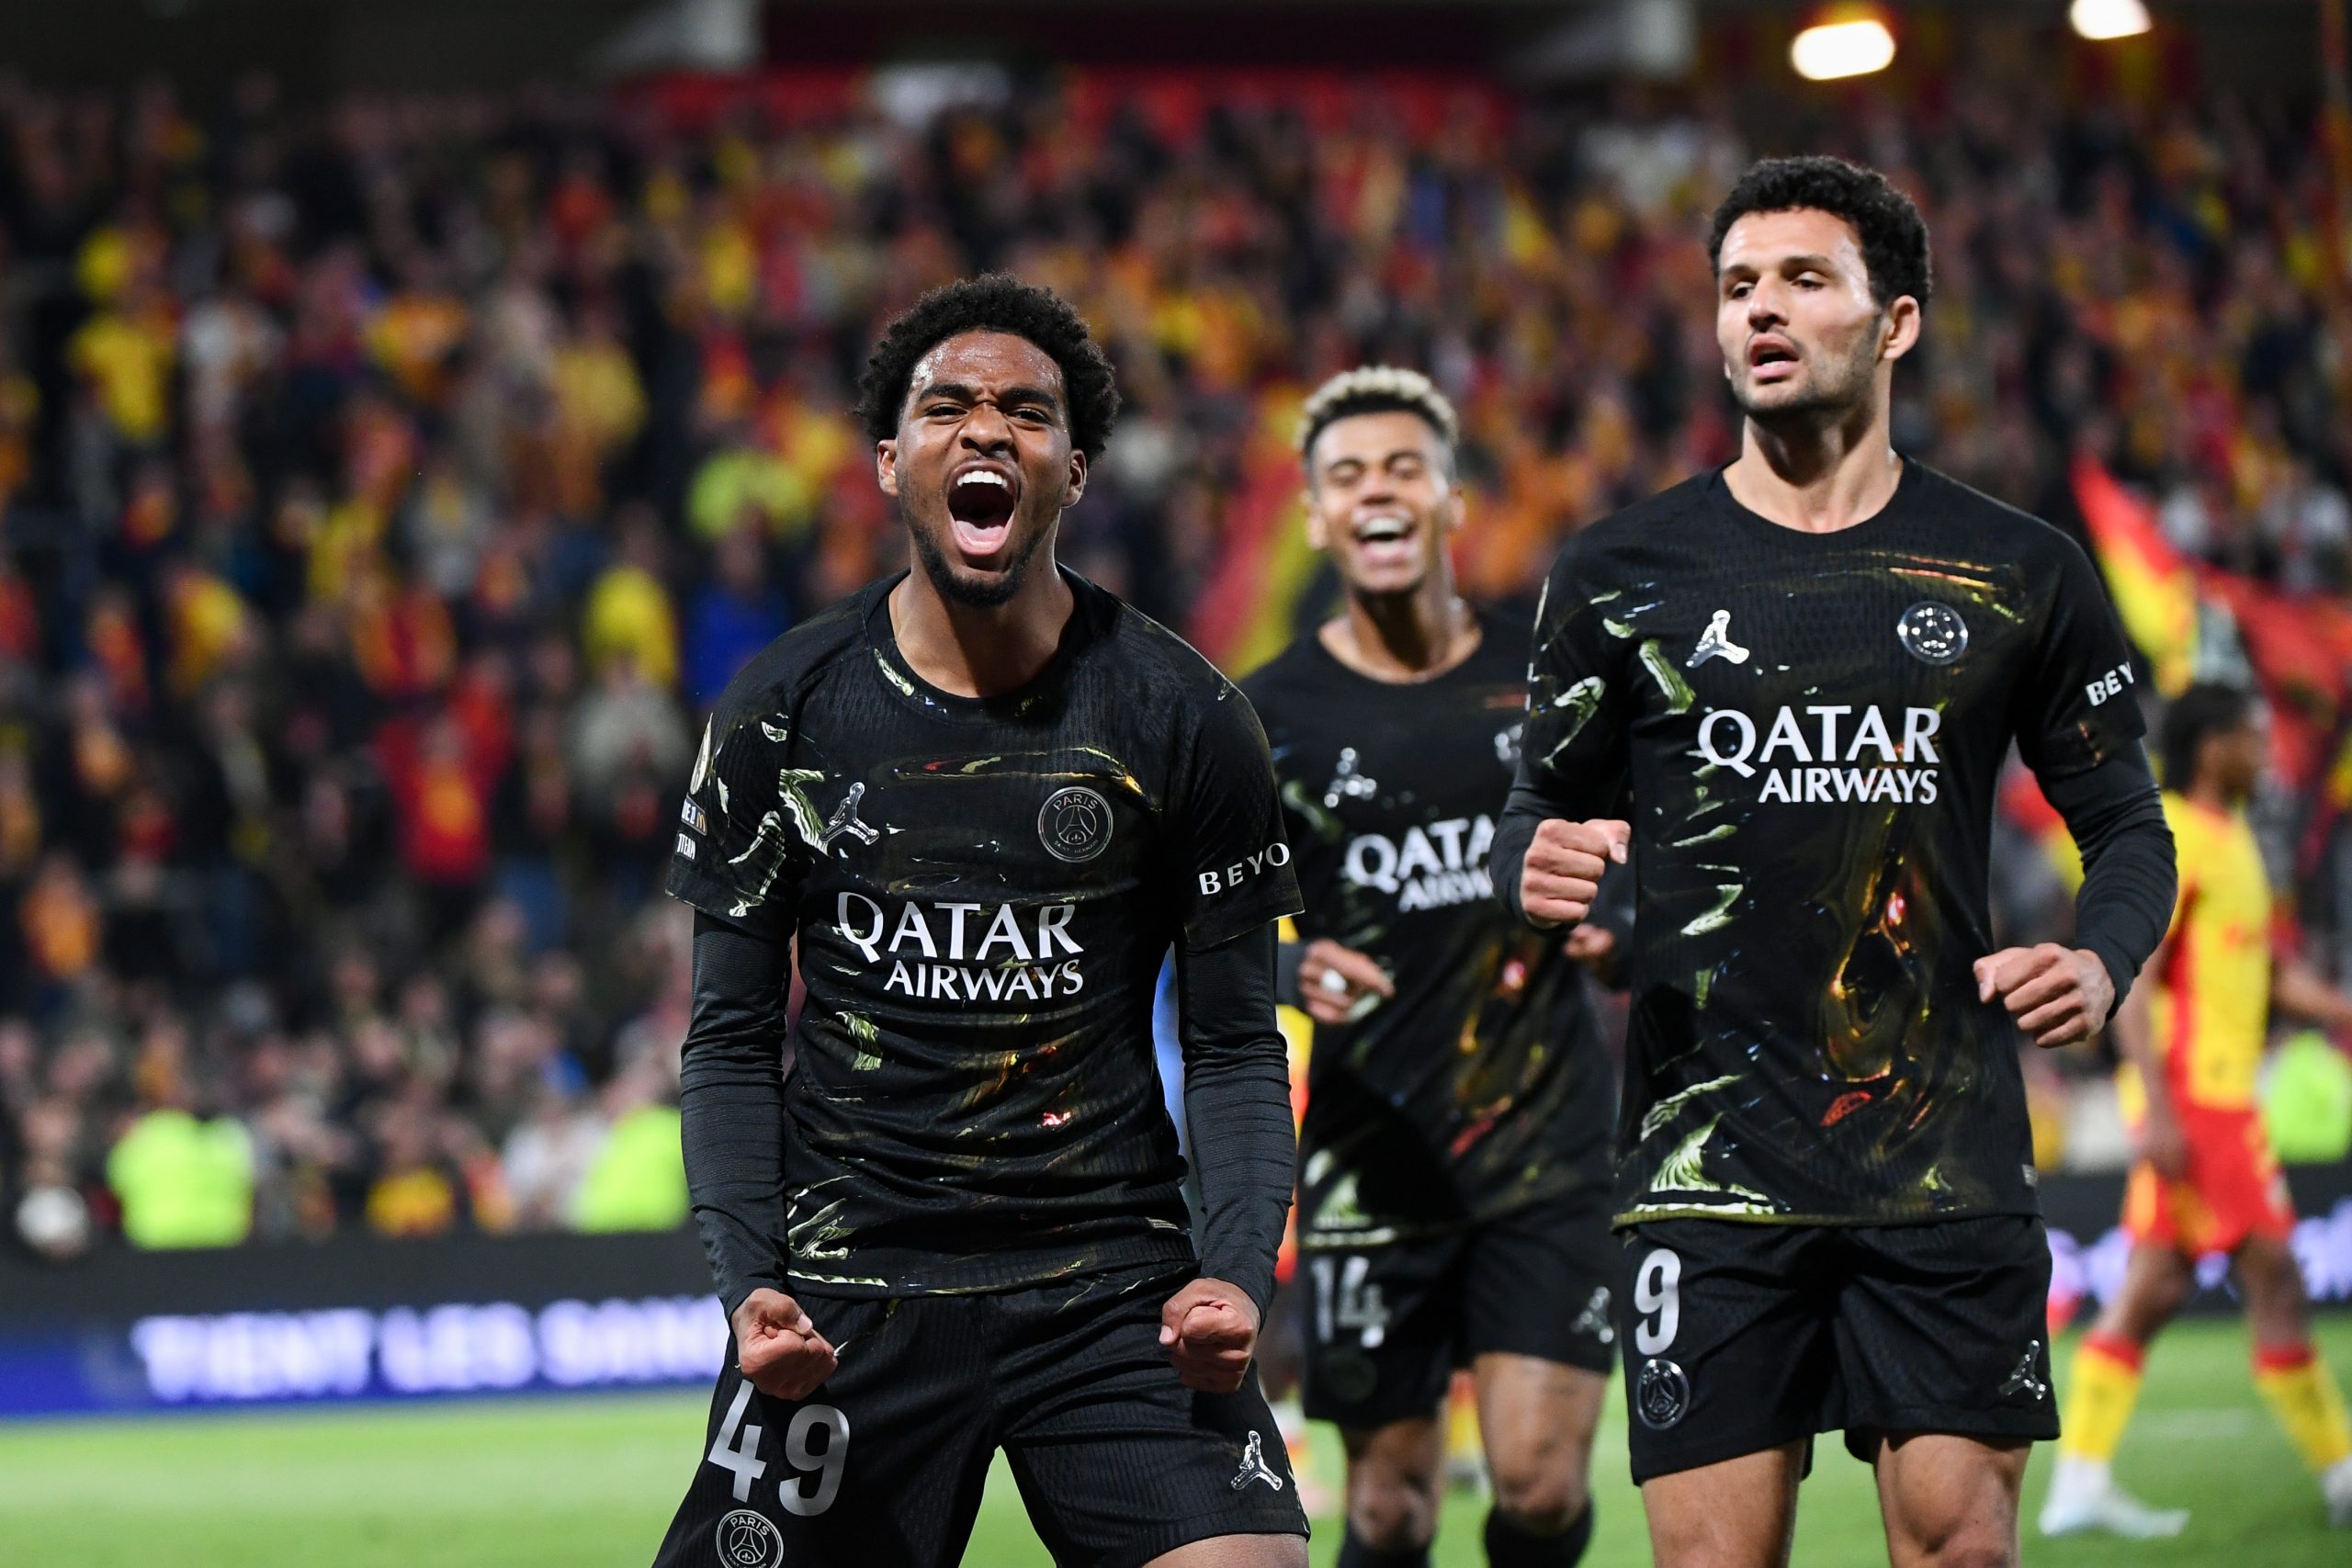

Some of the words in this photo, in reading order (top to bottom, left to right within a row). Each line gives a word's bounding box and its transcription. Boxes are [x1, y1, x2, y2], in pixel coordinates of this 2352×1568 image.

[2085, 661, 2134, 706] BEY
[1698, 705, 1941, 778] QATAR
[1053, 794, 1099, 811] PARIS
[1758, 768, 1939, 804] AIRWAYS
[1198, 842, 1290, 896] BEYO
[838, 891, 1084, 964] QATAR
[883, 959, 1084, 1001] AIRWAYS
[1311, 1256, 1392, 1348] 14
[1634, 1248, 1681, 1355] 9
[379, 1303, 535, 1391] LES
[537, 1294, 727, 1383] SAN
[707, 1379, 850, 1517] 49
[729, 1516, 770, 1536] PARIS
